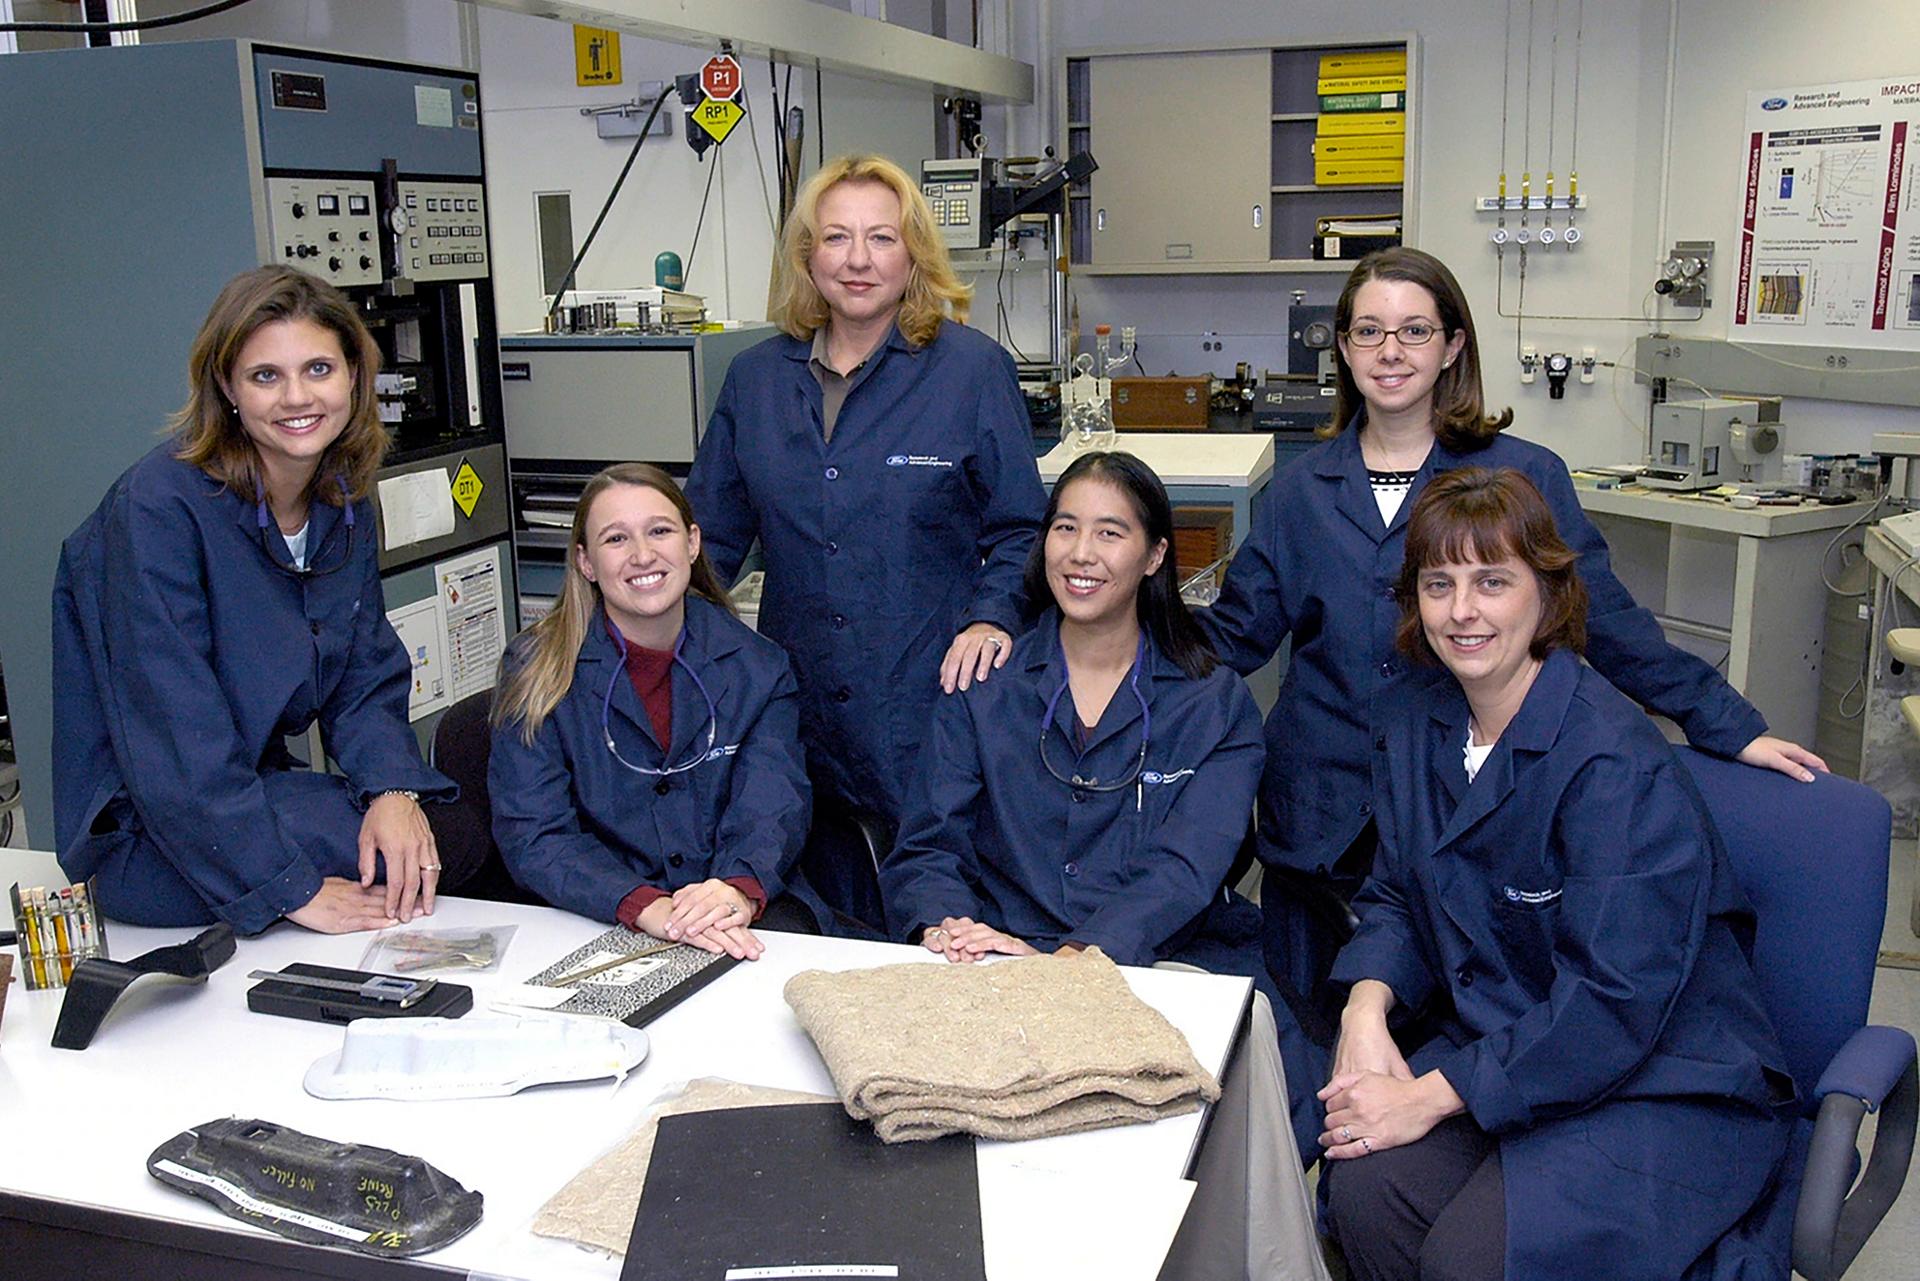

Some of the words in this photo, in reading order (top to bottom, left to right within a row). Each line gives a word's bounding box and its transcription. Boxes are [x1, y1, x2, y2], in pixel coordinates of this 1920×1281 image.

[713, 71, 730, 85] P1
[1793, 100, 1826, 109] Advanced
[1828, 97, 1871, 107] Engineering
[1794, 92, 1825, 101] Research
[1827, 91, 1841, 99] and
[705, 105, 728, 118] RP1
[1890, 142, 1902, 192] Laminates
[1887, 194, 1897, 213] Film
[1881, 247, 1892, 275] Aging
[1739, 281, 1749, 315] Painted
[1876, 275, 1888, 315] Thermal
[460, 481, 474, 495] DT1
